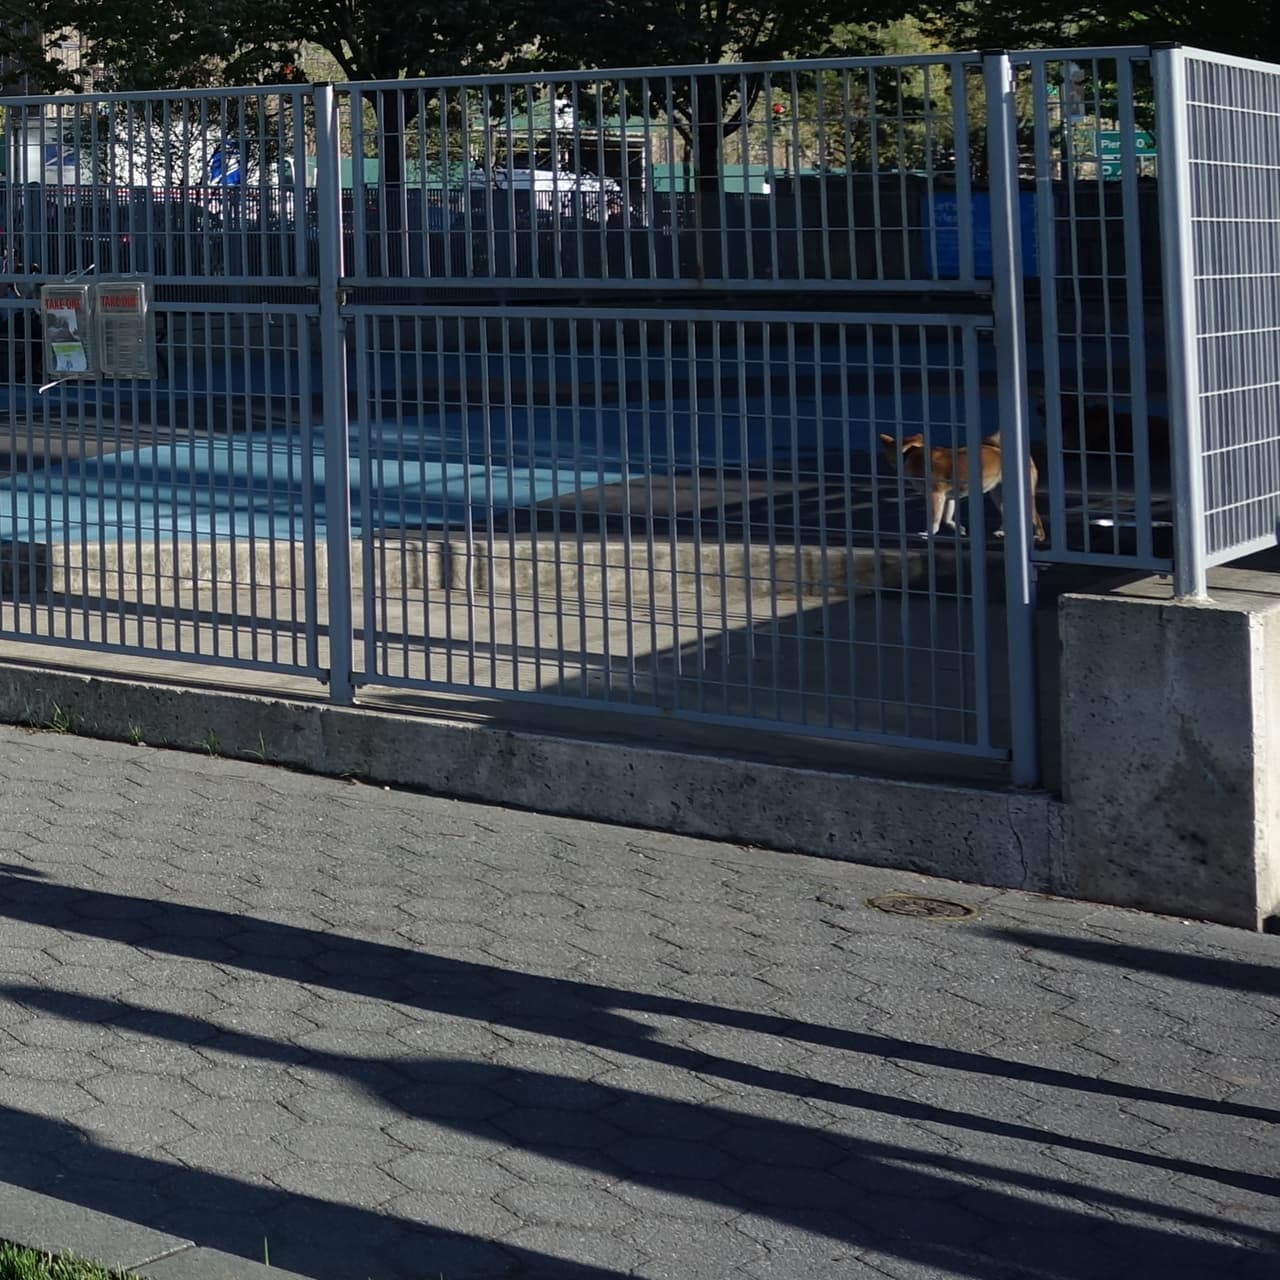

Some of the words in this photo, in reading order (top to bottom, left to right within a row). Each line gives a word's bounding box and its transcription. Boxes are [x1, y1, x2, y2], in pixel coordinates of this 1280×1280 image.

[1101, 139, 1121, 149] Pier
[45, 298, 65, 310] TAKE
[66, 298, 82, 310] ONE
[100, 295, 121, 307] TAKE
[122, 295, 137, 307] ONE
